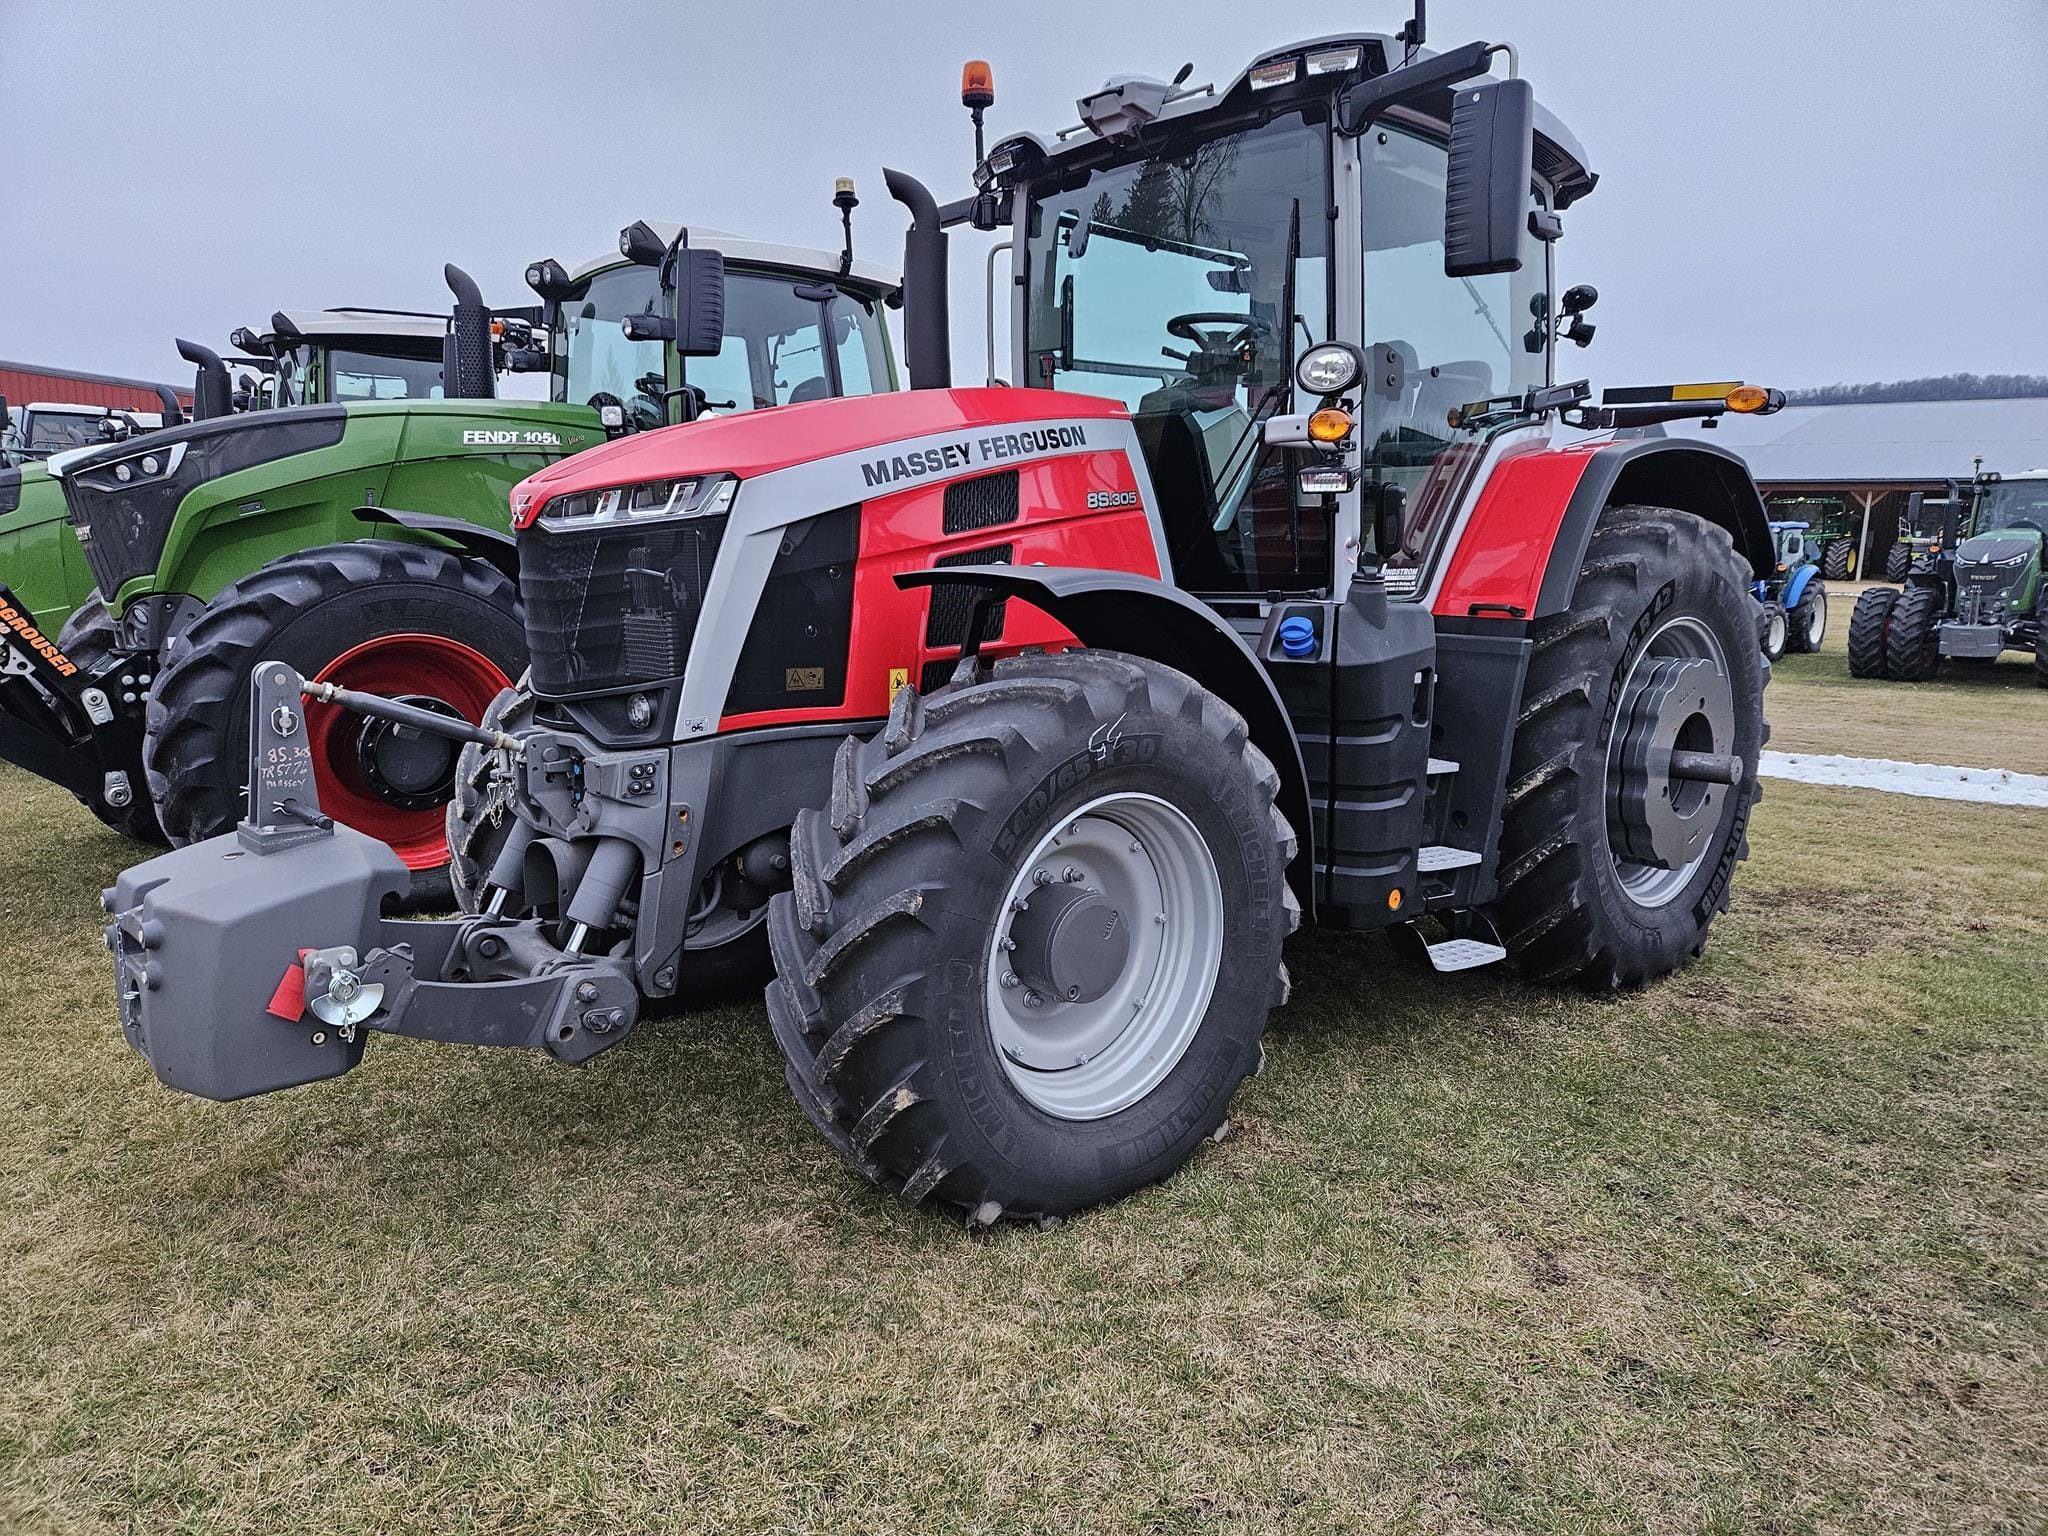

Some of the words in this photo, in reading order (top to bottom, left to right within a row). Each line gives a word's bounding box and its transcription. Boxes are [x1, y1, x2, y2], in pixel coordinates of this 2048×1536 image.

[463, 430, 518, 444] FENDT
[523, 432, 561, 445] 1050
[861, 442, 971, 487] MASSEY
[979, 425, 1087, 461] FERGUSON
[1087, 491, 1137, 509] 8S.305
